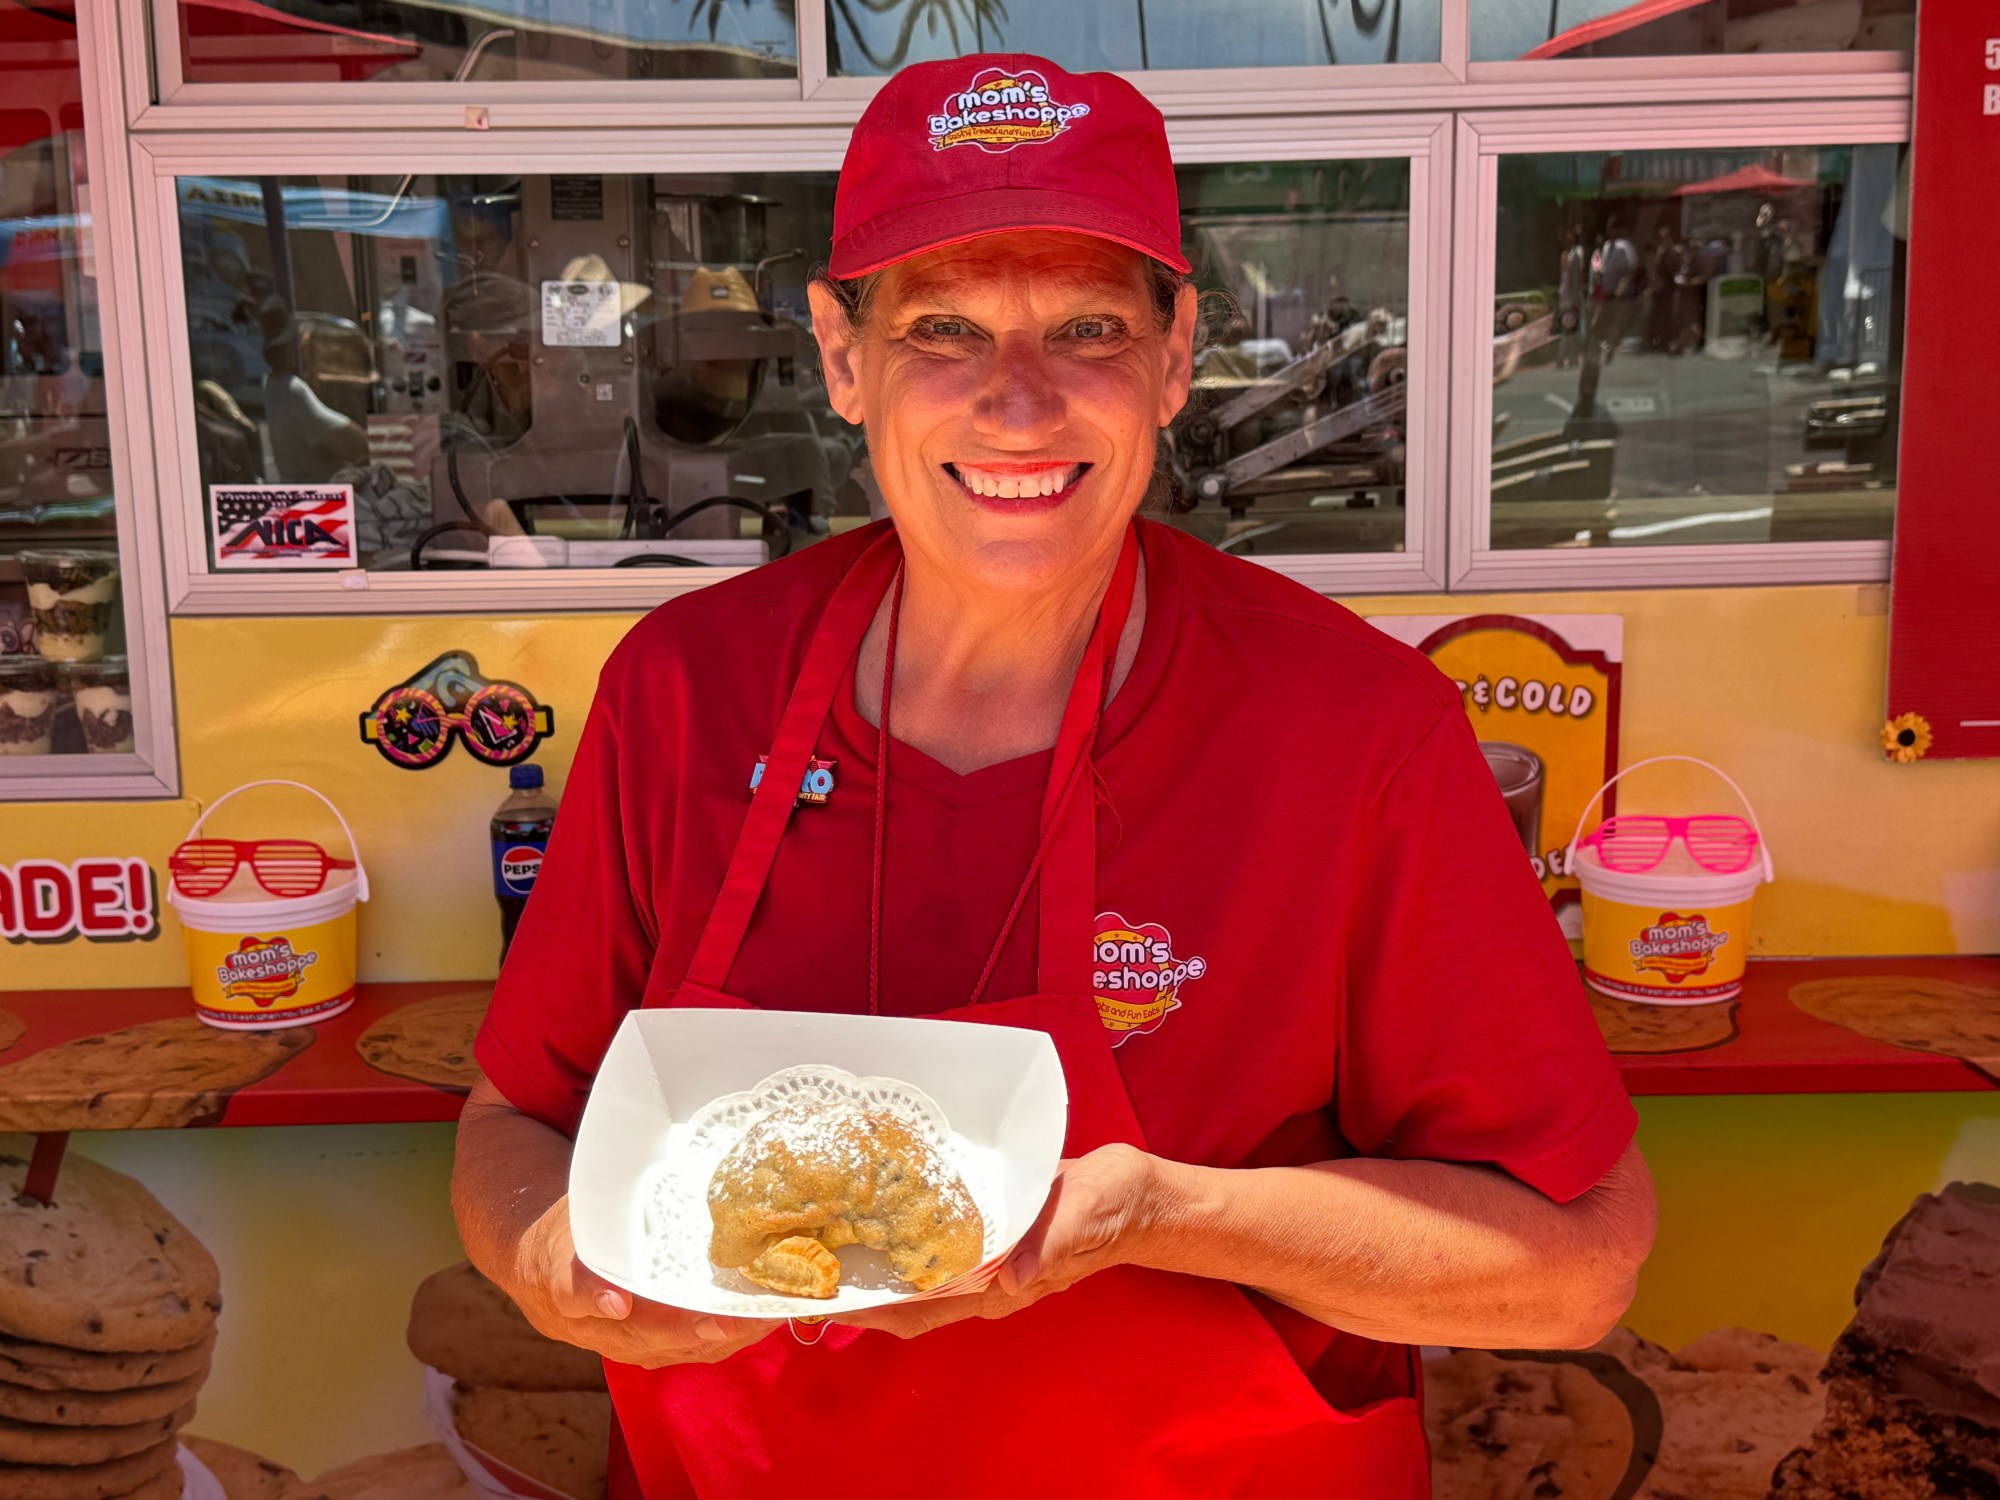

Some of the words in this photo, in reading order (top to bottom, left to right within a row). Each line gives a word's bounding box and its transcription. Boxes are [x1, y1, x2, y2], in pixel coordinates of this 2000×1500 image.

[958, 81, 1048, 110] mom's
[929, 104, 1090, 133] Bakeshoppe
[503, 863, 541, 875] PEPS
[1630, 931, 1729, 957] Bakeshoppe
[1649, 921, 1707, 942] mom's
[217, 951, 318, 983] Bakeshoppe
[232, 944, 291, 967] mom's
[1093, 957, 1205, 991] eshoppe
[1111, 1007, 1126, 1018] and
[1127, 1009, 1142, 1020] Fun
[1143, 1006, 1160, 1019] Eats
